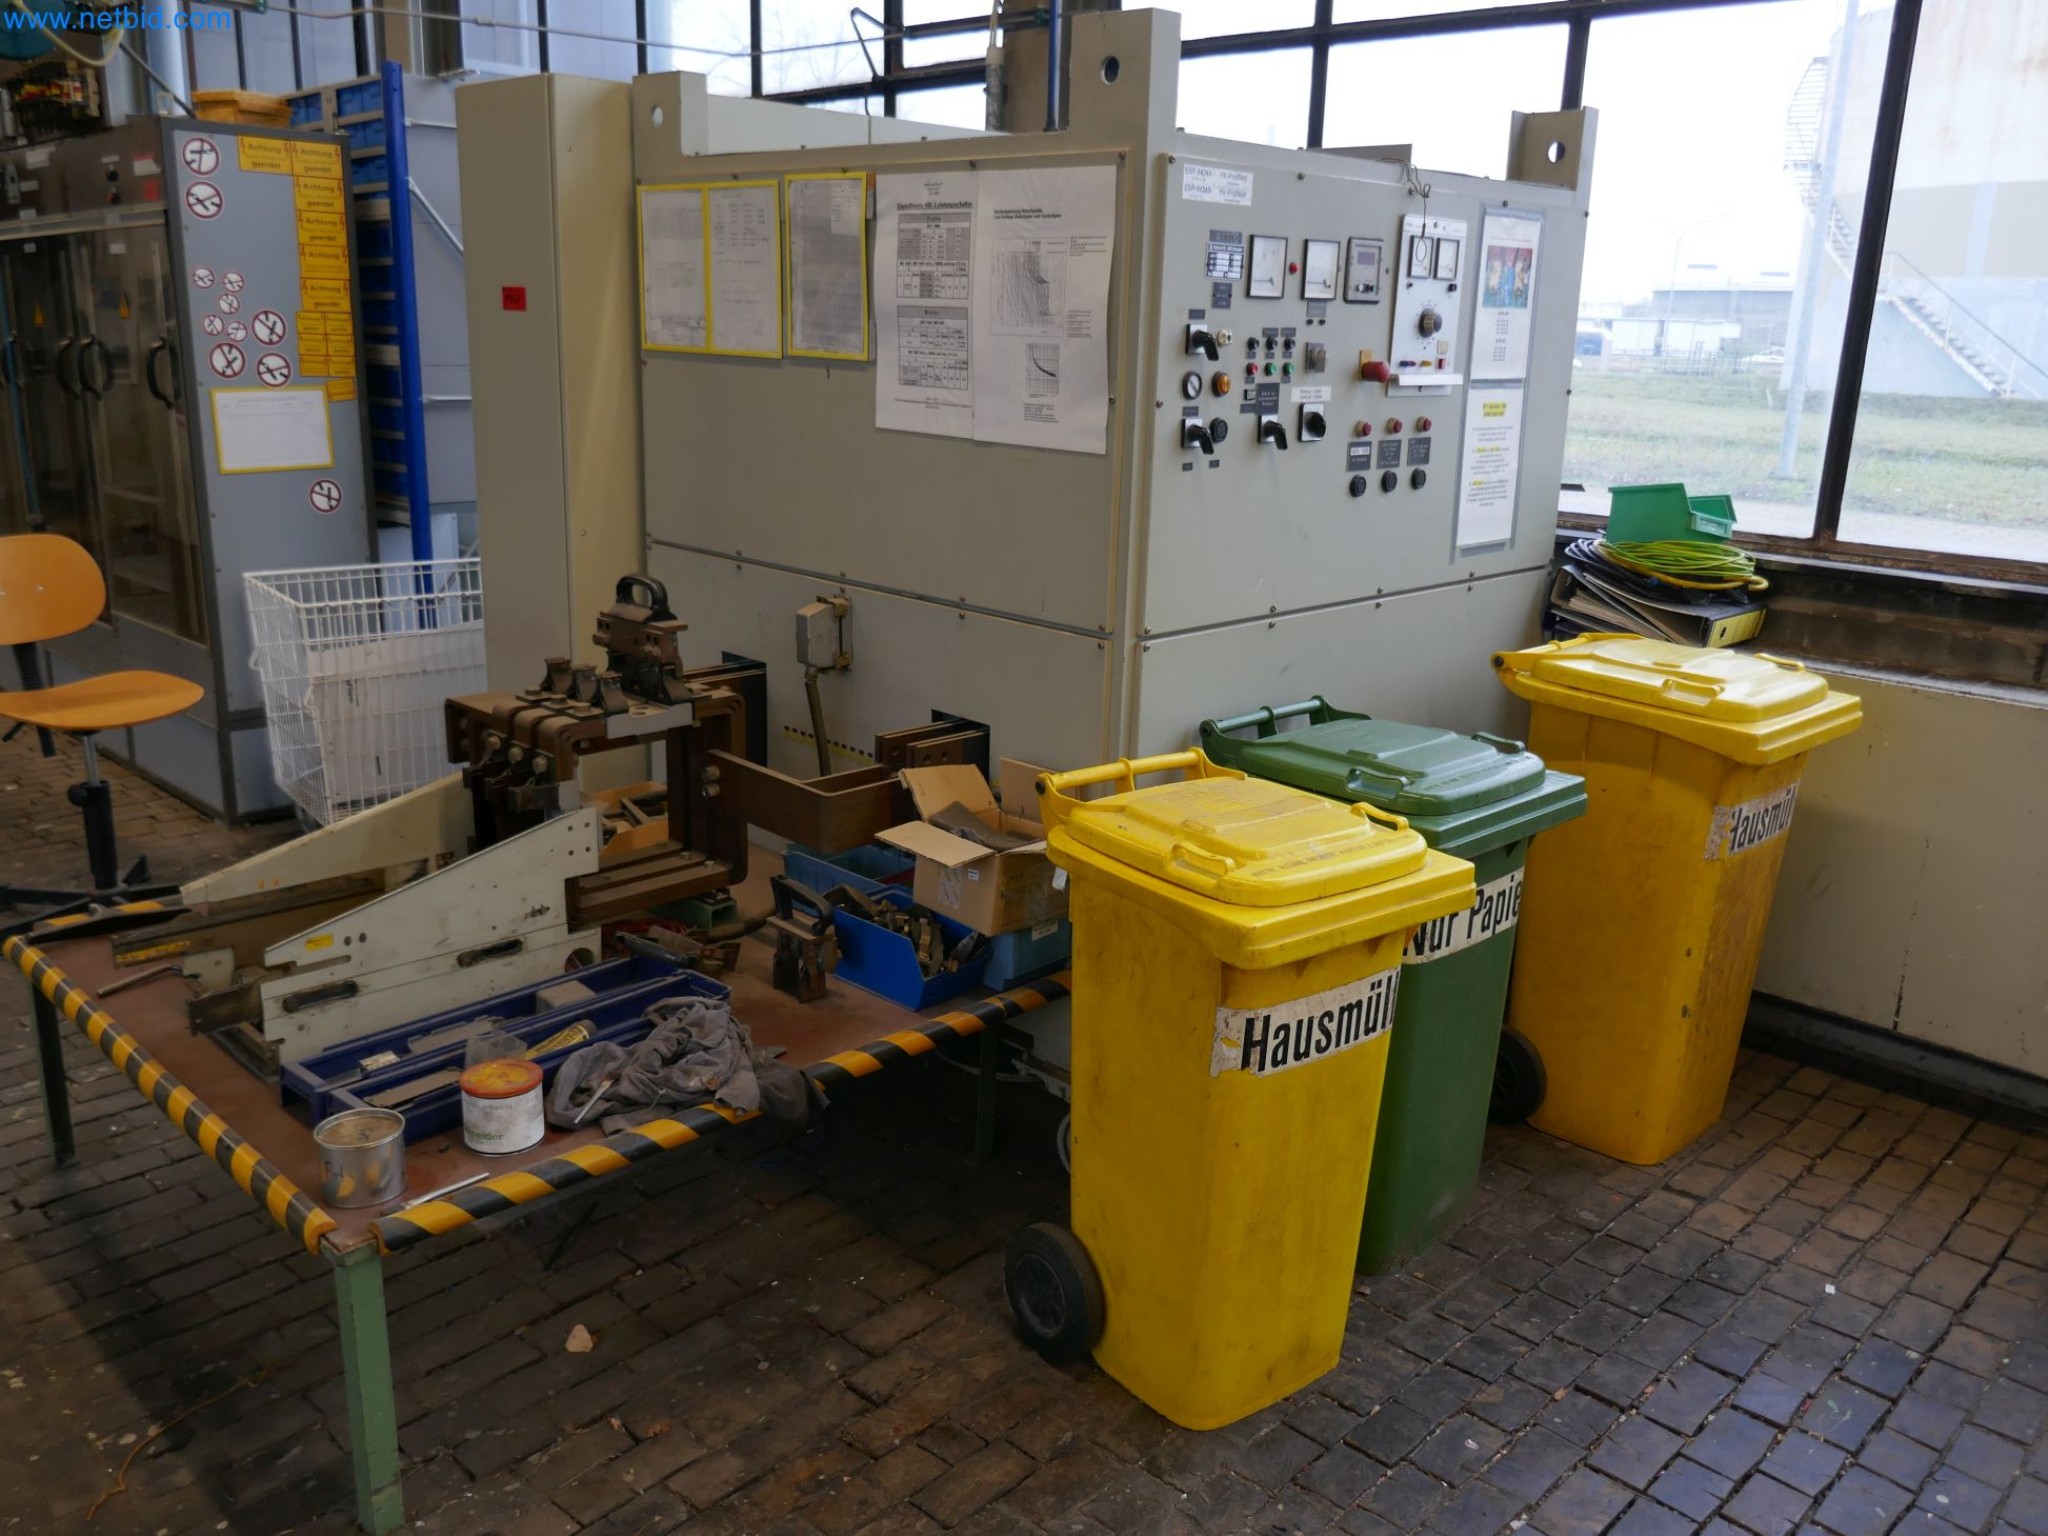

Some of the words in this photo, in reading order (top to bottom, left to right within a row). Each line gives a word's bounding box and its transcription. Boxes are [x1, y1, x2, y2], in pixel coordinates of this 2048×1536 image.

[248, 143, 282, 154] Achtung
[300, 147, 333, 158] Achtung
[303, 182, 336, 193] Achtung
[305, 217, 338, 228] Achtung
[308, 250, 341, 261] Achtung
[310, 284, 342, 295] Achtung
[1729, 785, 1796, 852] Hausmül
[1402, 911, 1460, 957] Nur
[1466, 873, 1523, 940] Papie
[1240, 970, 1400, 1073] Hausmüll
